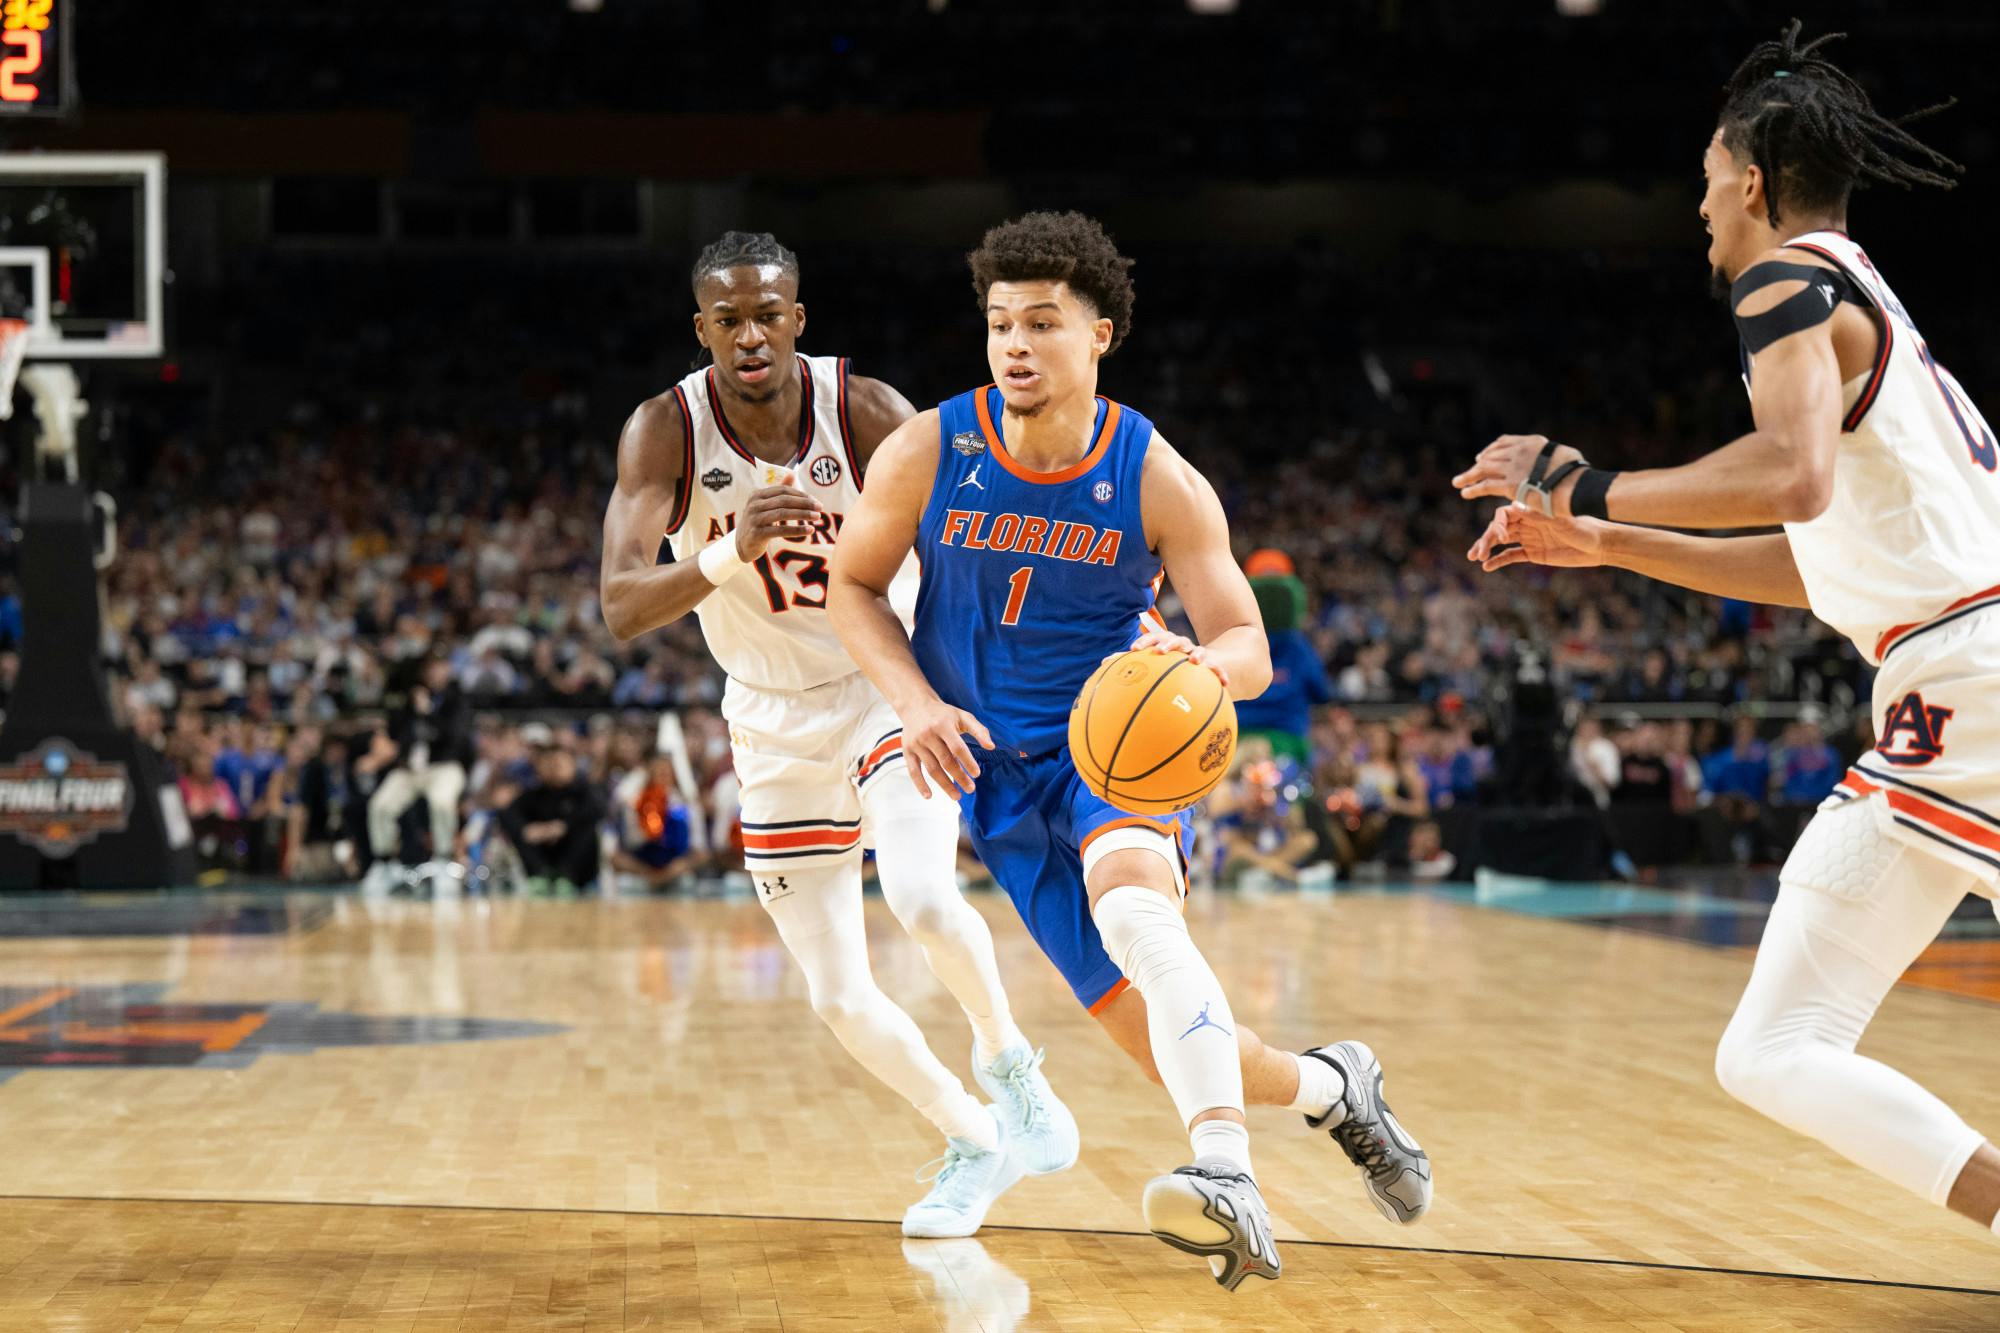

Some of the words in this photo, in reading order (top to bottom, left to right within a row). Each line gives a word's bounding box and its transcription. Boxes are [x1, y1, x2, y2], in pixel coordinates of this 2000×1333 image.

[812, 456, 840, 485] SEC
[1094, 483, 1113, 500] SEC
[940, 509, 1122, 566] FLORIDA
[752, 548, 829, 613] 13
[1000, 566, 1033, 625] 1
